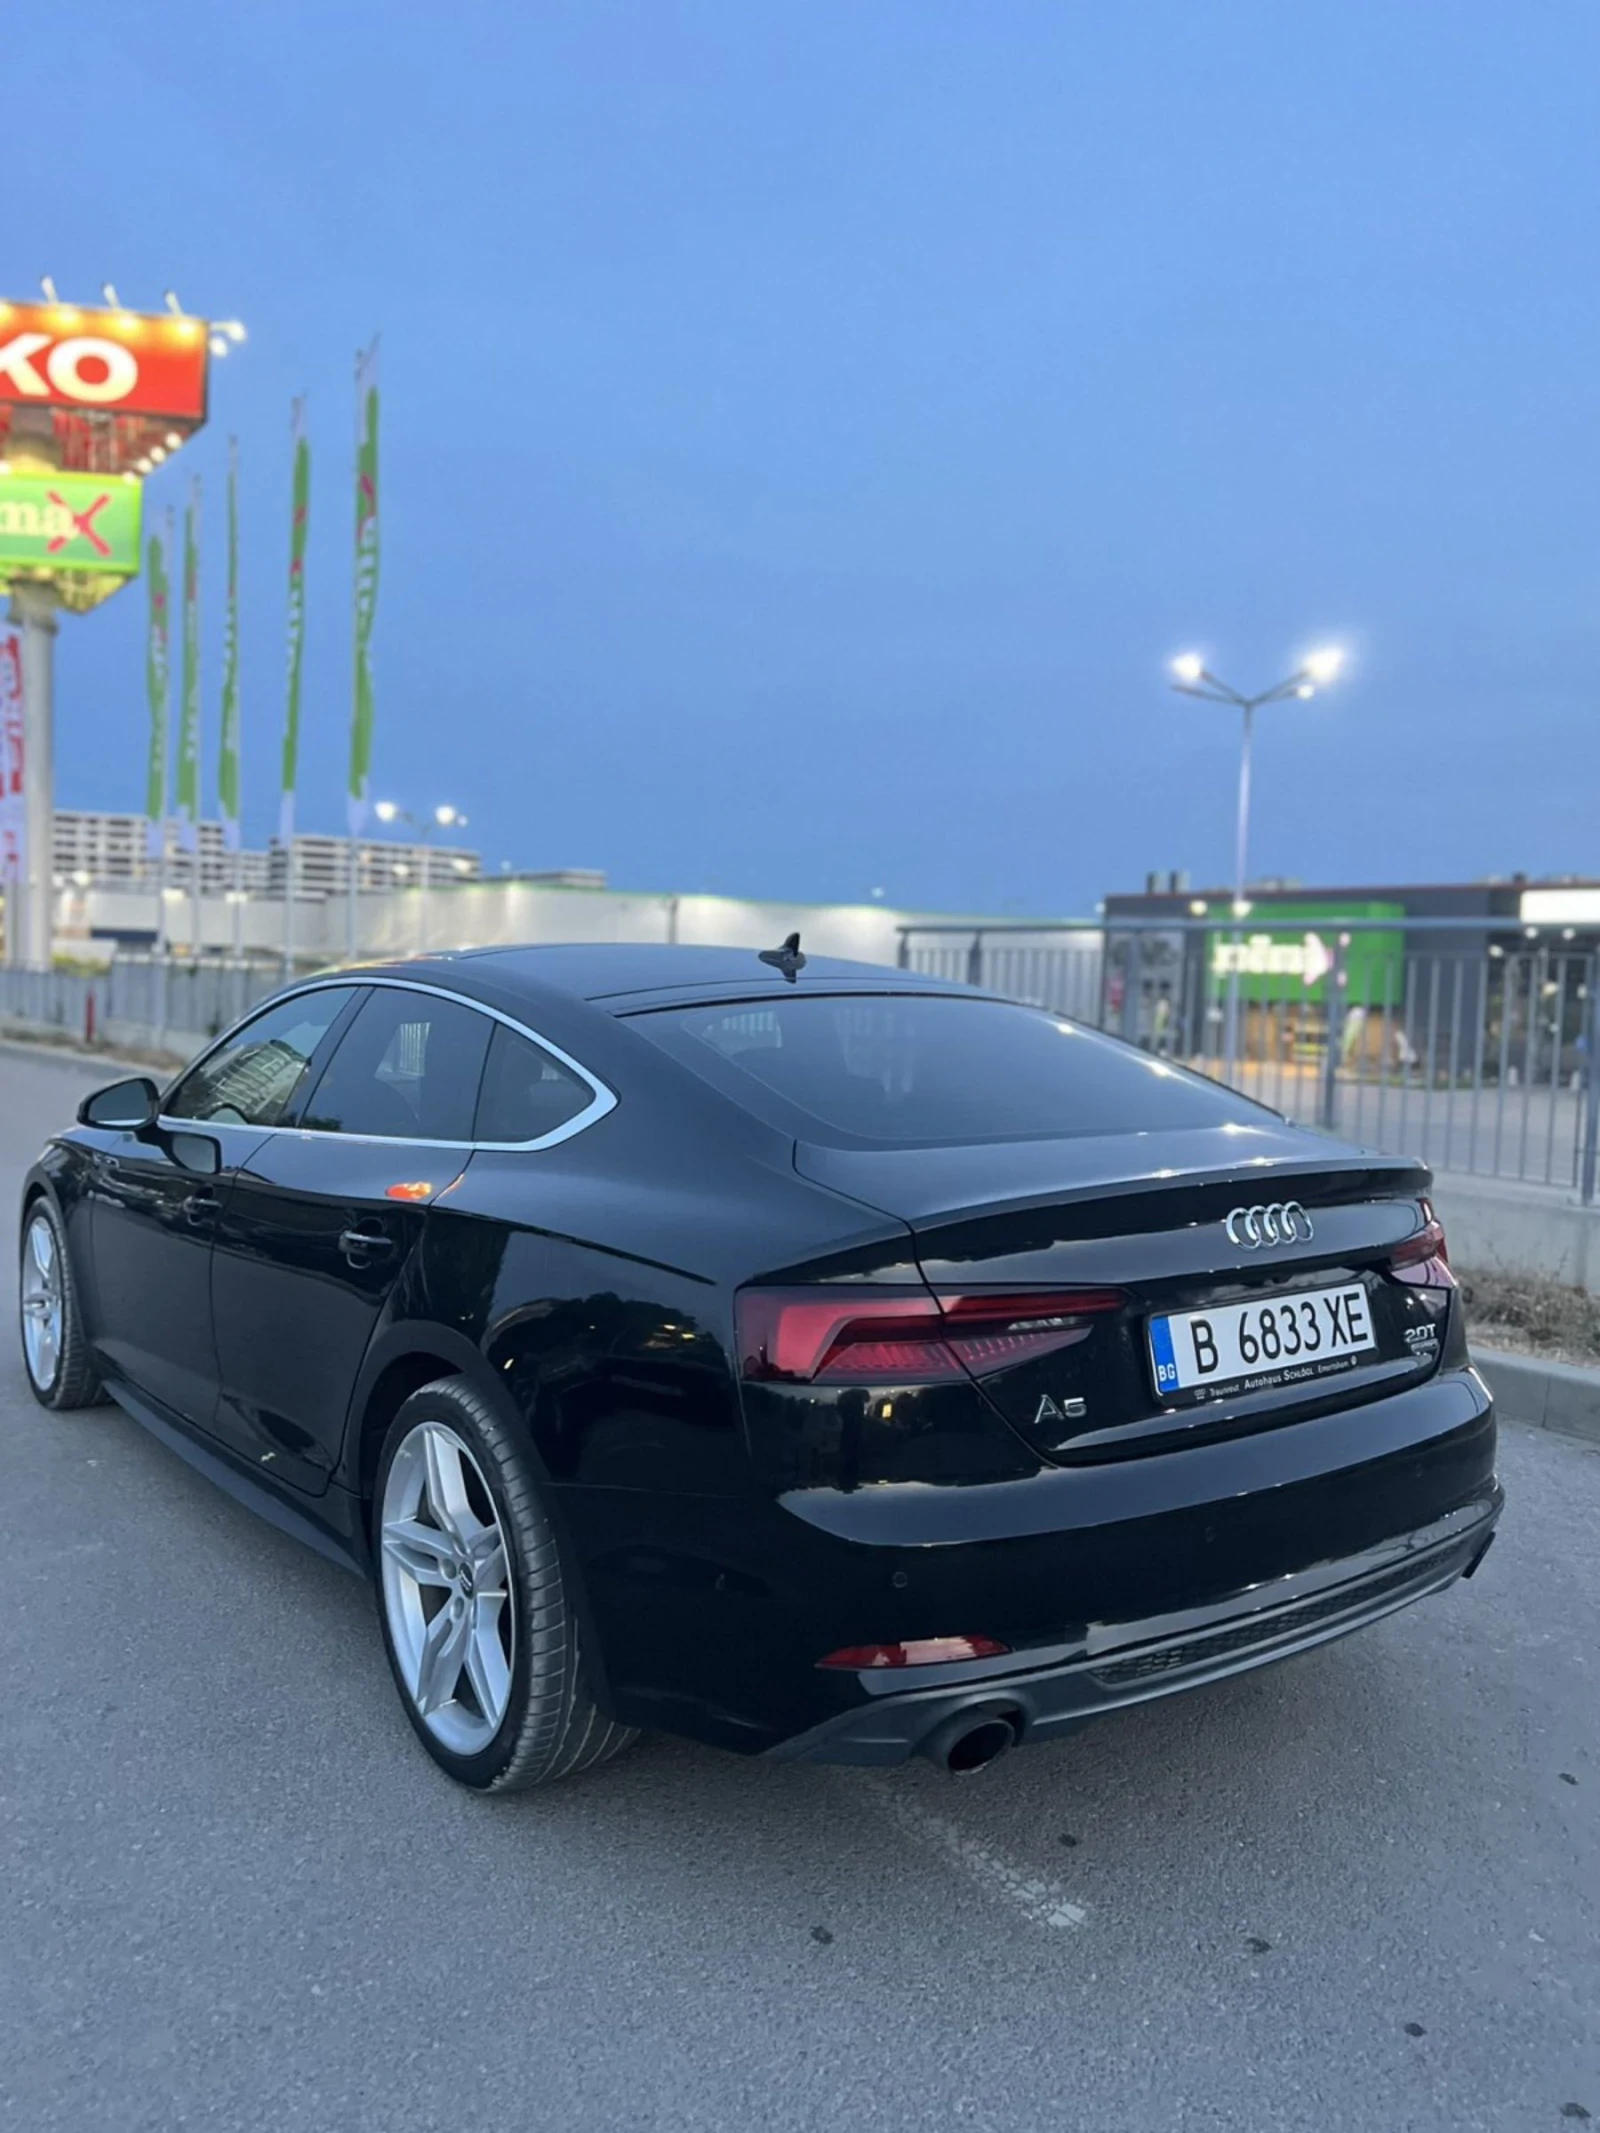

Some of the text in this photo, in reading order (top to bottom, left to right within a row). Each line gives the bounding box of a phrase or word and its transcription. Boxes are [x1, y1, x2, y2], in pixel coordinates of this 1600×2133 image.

[1190, 1292, 1368, 1374] B 6833 XE
[1158, 1364, 1176, 1382] BG
[1244, 1374, 1282, 1389] Autohaus
[1034, 1394, 1087, 1424] A5
